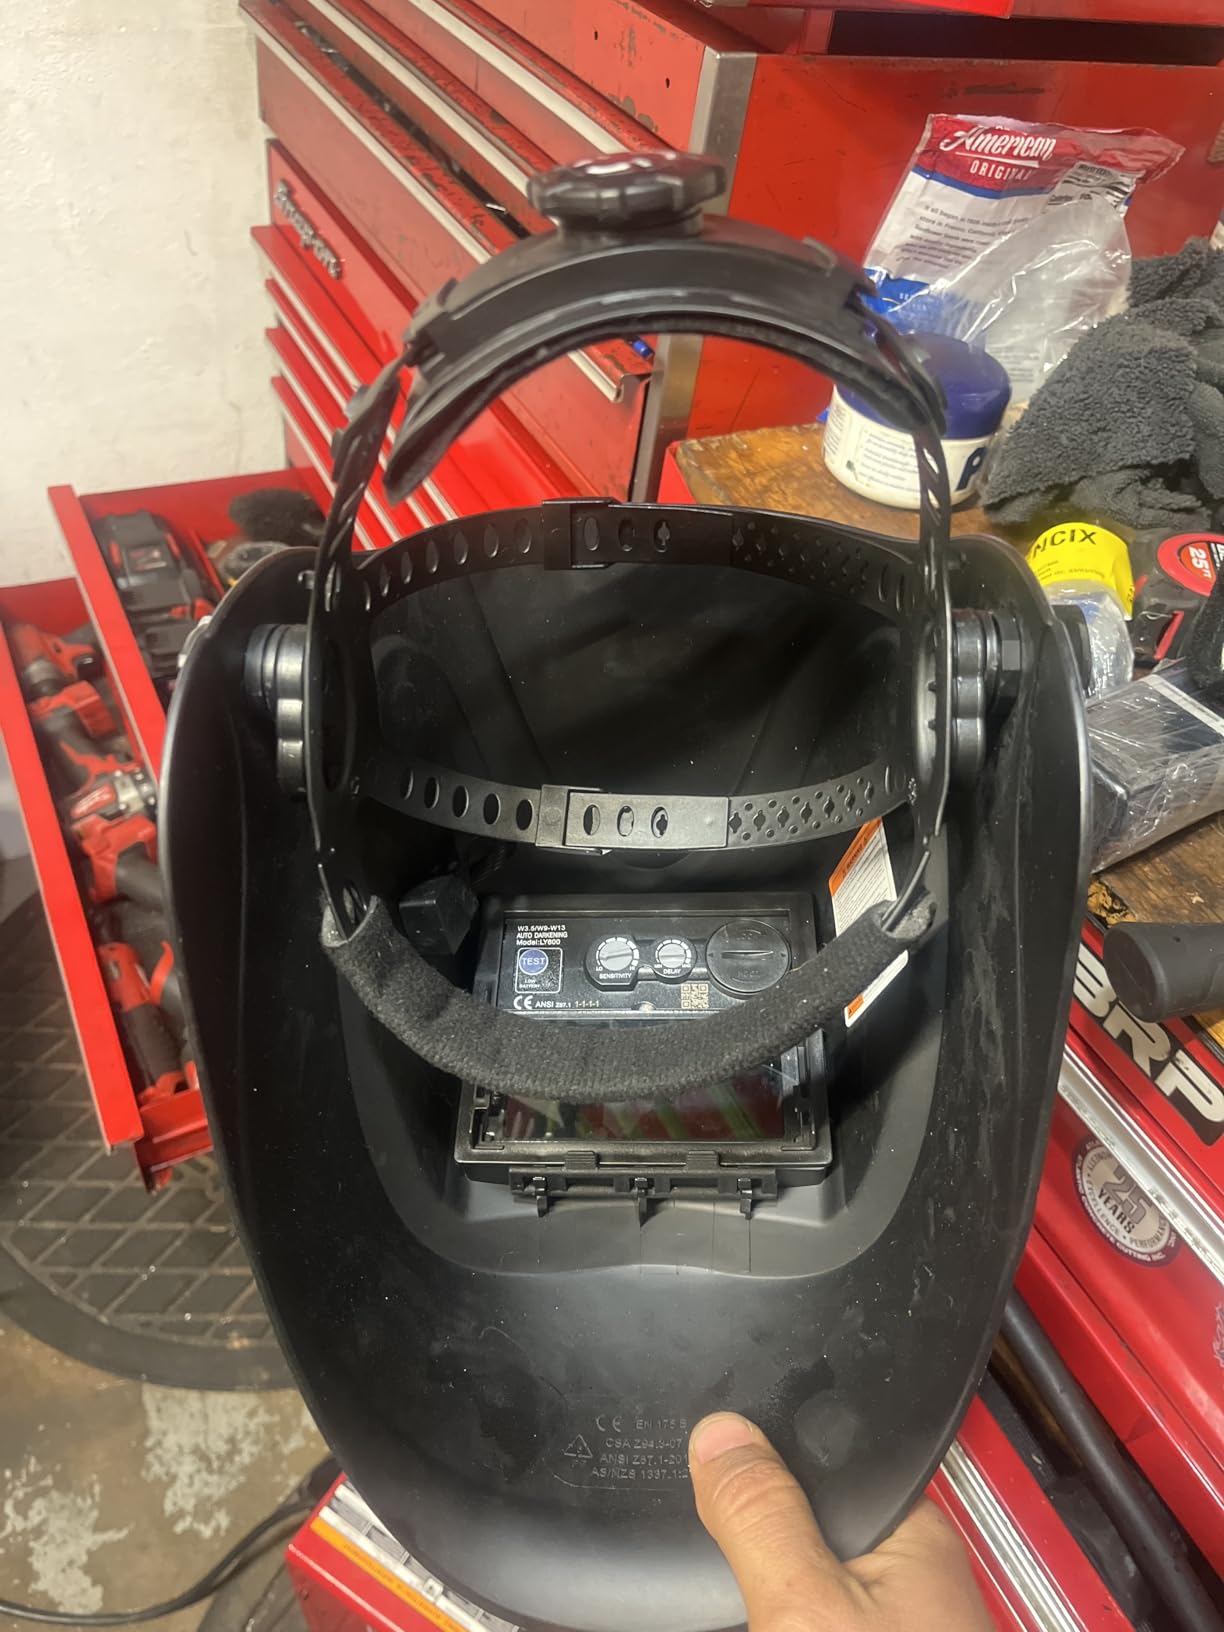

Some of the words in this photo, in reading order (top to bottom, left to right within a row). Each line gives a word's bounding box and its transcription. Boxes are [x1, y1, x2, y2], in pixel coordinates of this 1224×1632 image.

[939, 125, 1057, 161] American
[534, 931, 568, 939] DARKENING
[521, 957, 546, 966] TEST
[535, 1000, 553, 1008] ANSI
[575, 1000, 599, 1008] 1-1-1-1
[1102, 1164, 1147, 1225] 25
[1098, 1188, 1136, 1234] YEARS
[636, 1419, 652, 1430] EN
[657, 1419, 676, 1430] 175
[605, 1438, 631, 1449] CSA
[600, 1453, 629, 1465] ANSI
[632, 1453, 689, 1466] Z87.1-201
[590, 1466, 636, 1479] AS/NZS
[640, 1468, 689, 1480] 1337.1:2
